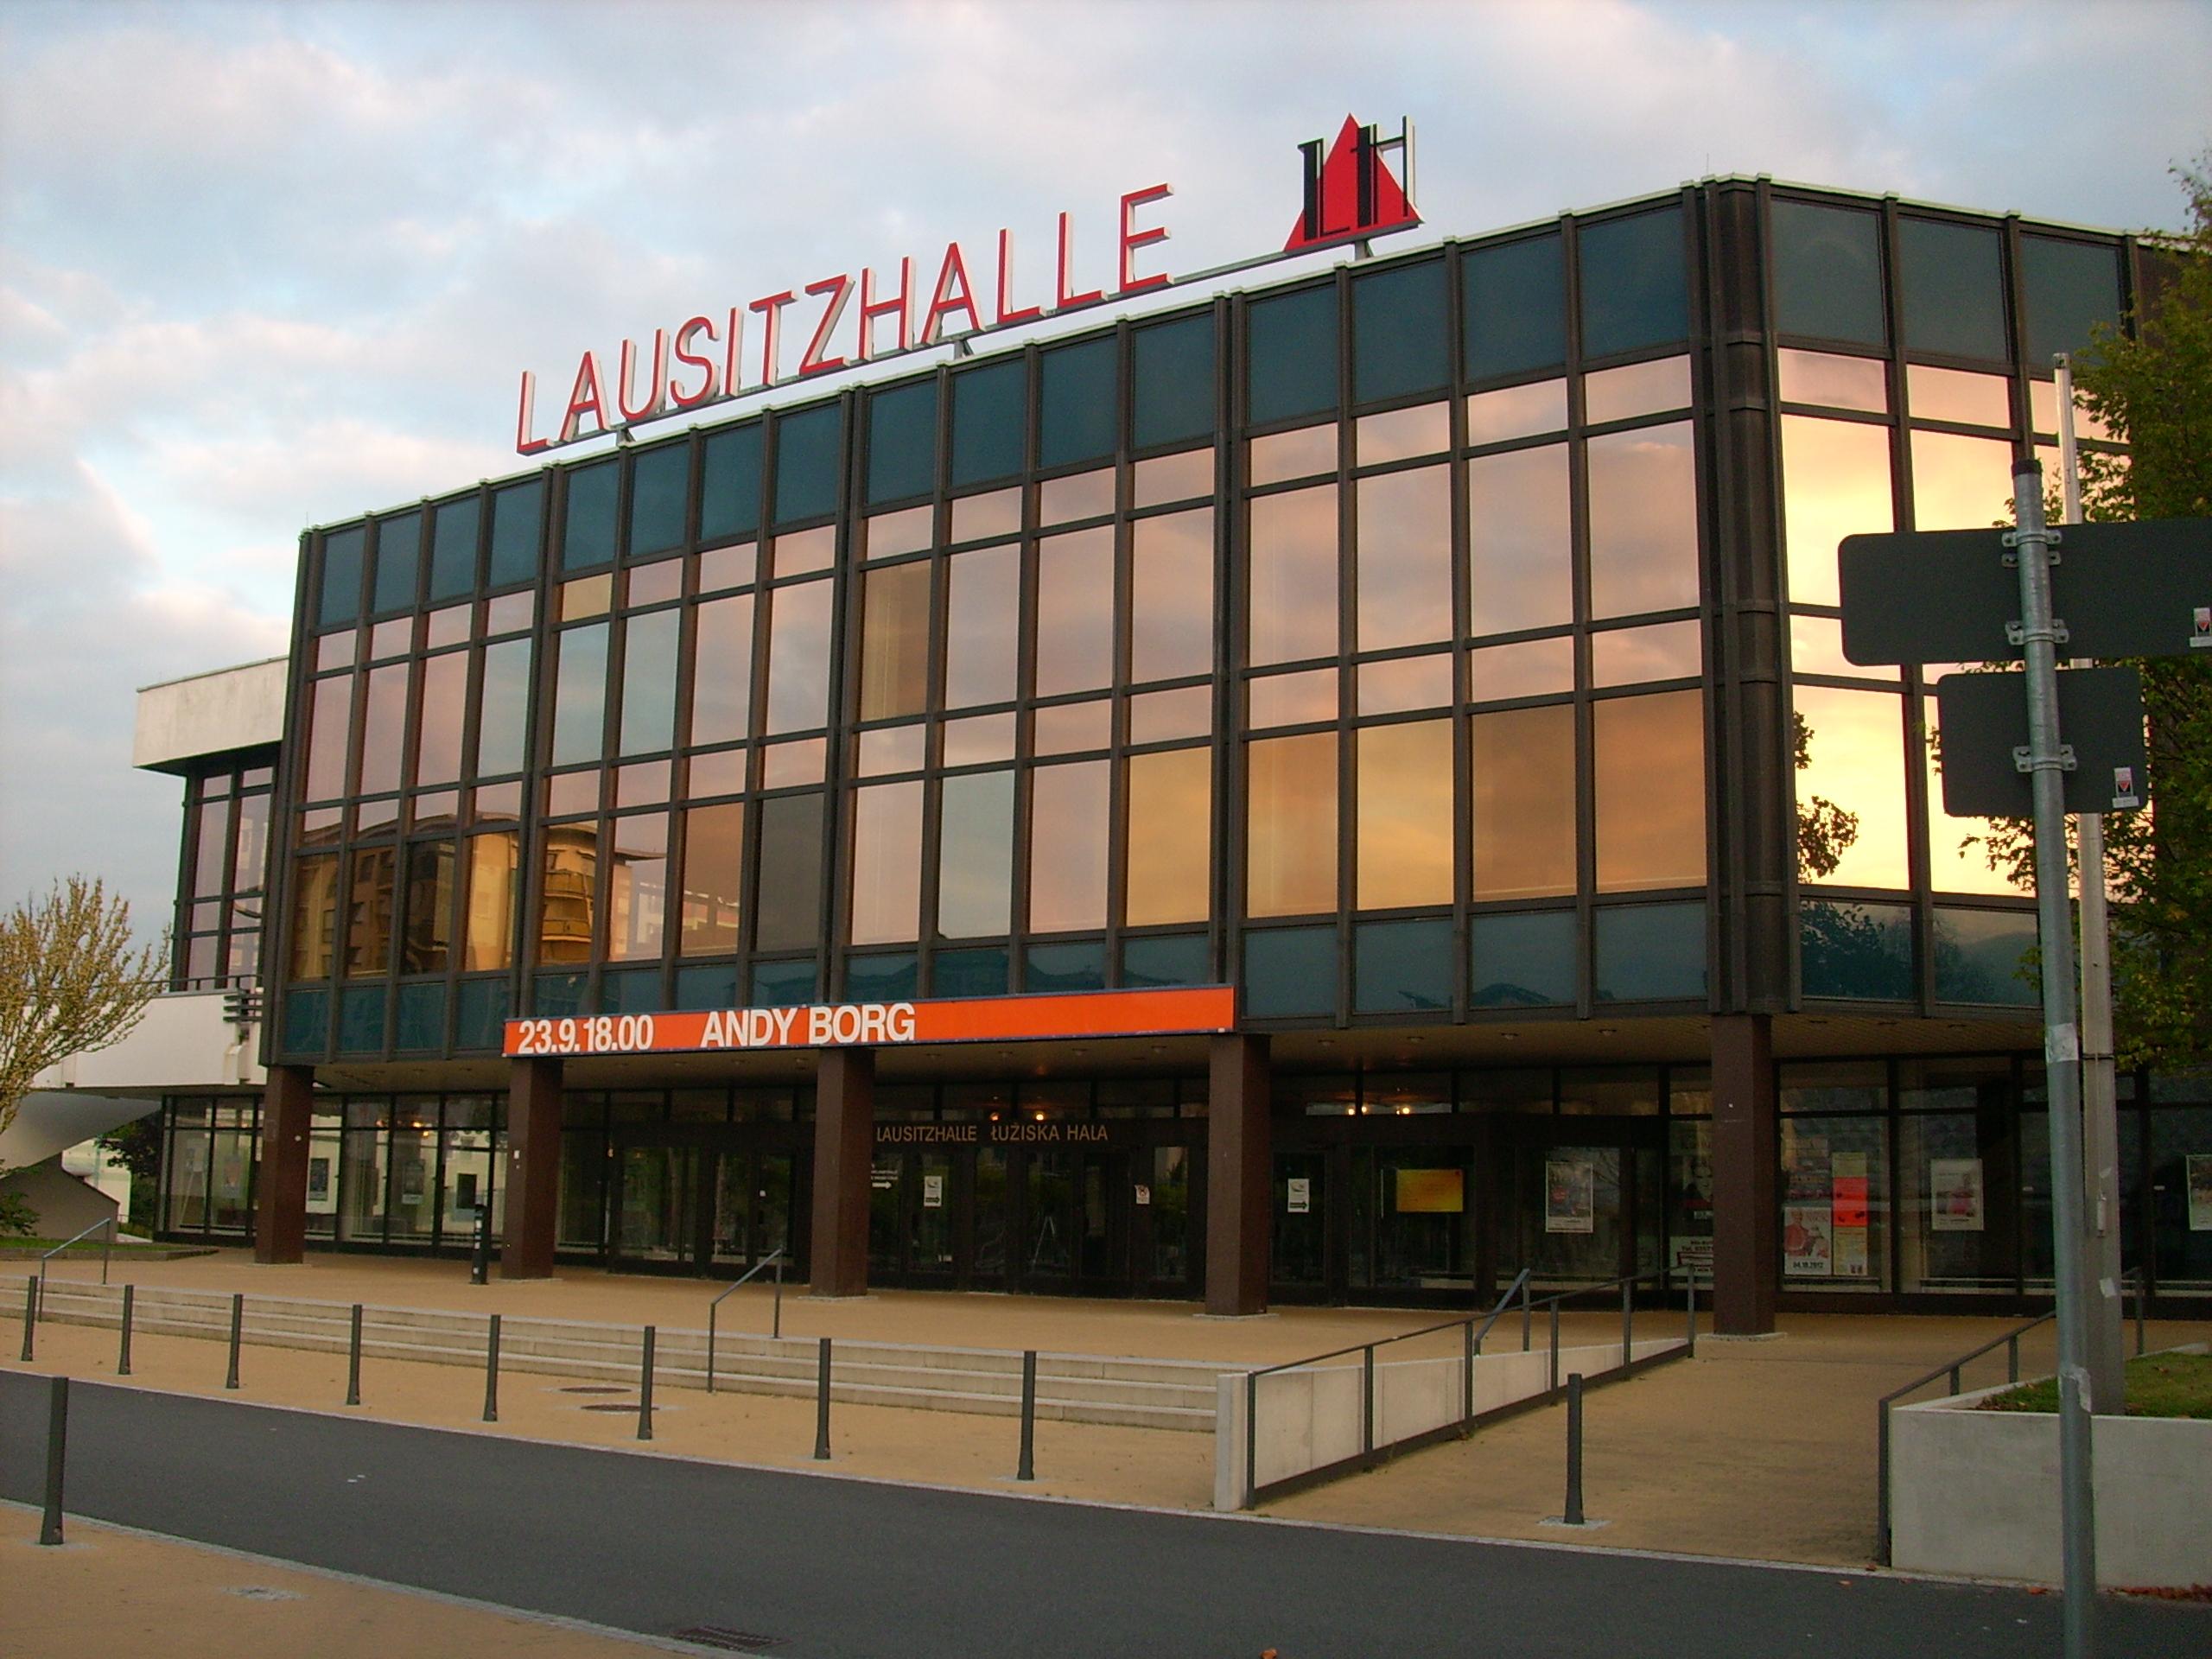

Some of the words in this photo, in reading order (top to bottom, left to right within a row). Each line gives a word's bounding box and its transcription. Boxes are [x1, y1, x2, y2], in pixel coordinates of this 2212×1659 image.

[517, 183, 1173, 455] LAUSITZHALLE
[700, 1007, 797, 1047] ANDY
[809, 1003, 915, 1044] BORG
[877, 1126, 976, 1141] LAUSITZHALLE
[1067, 1125, 1108, 1141] HALA
